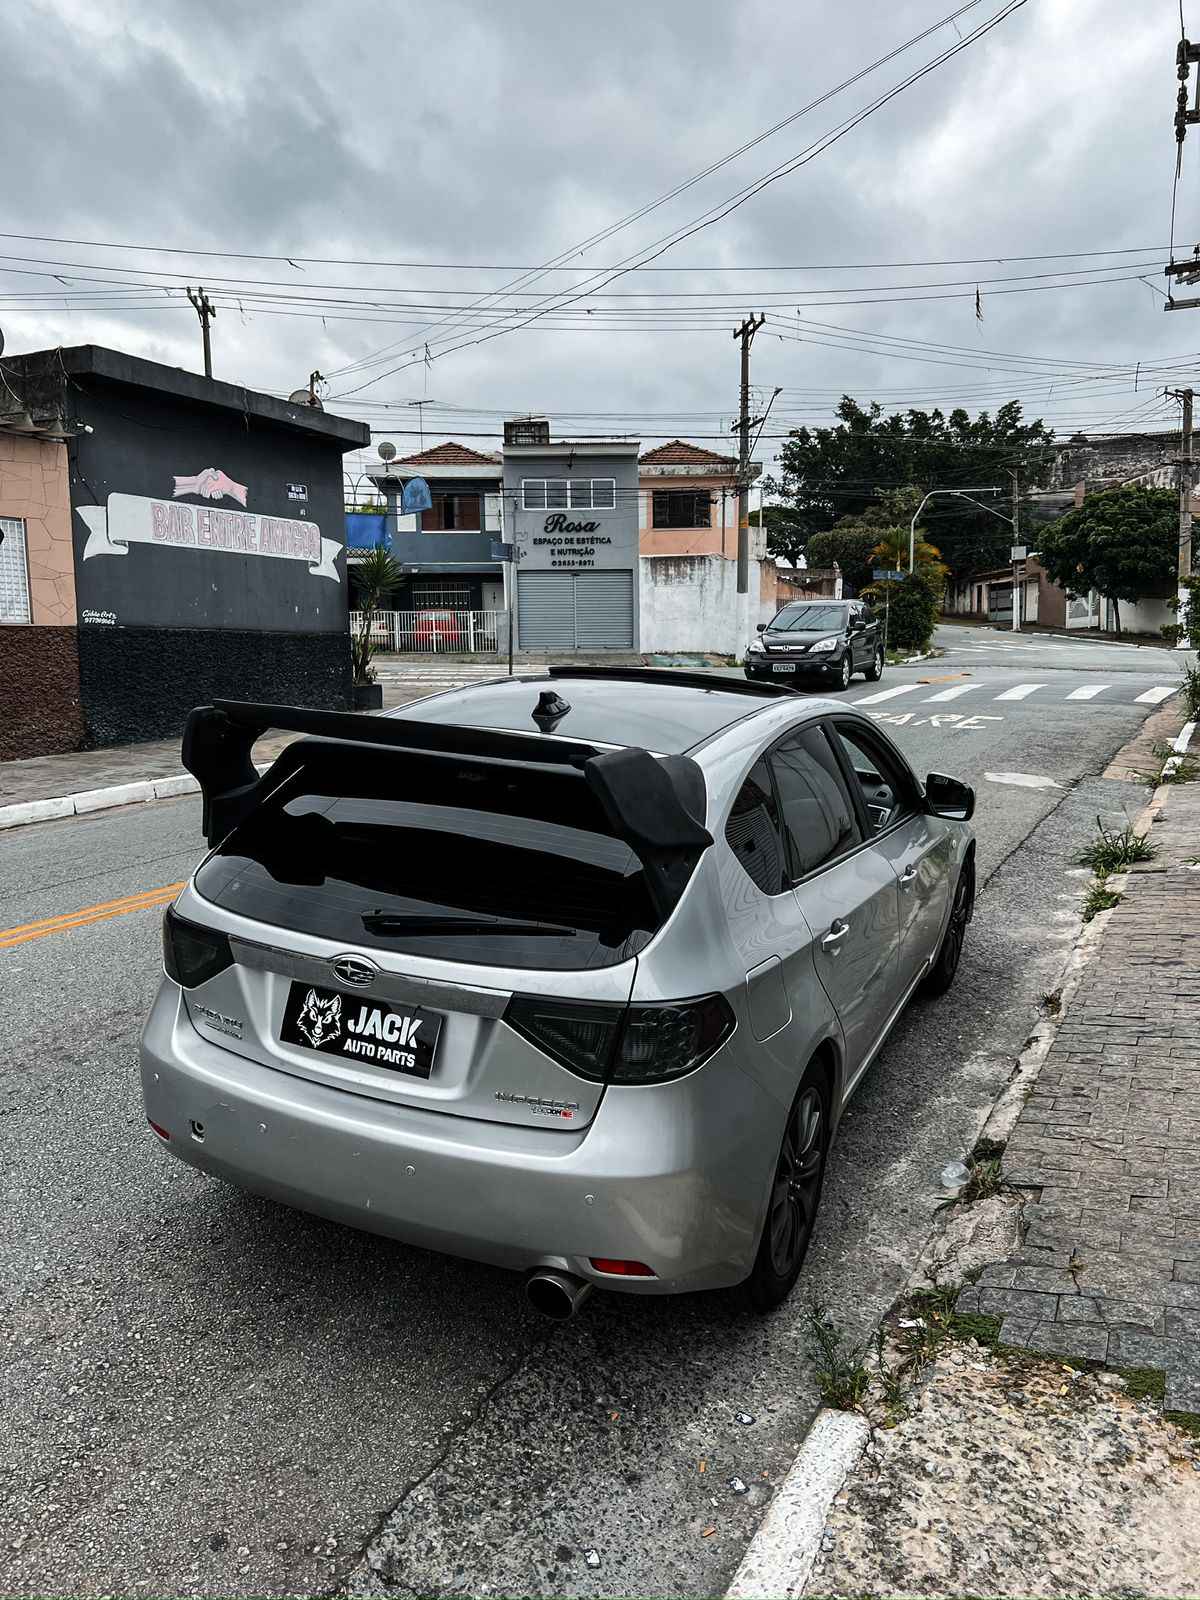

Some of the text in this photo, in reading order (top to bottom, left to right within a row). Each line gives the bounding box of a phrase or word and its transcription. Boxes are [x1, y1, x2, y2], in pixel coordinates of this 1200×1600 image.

[151, 501, 321, 559] BAR ENTRE AMIGOS
[544, 513, 601, 534] Rosa
[533, 535, 612, 546] ESPAÇO DE ESTÉTICA
[550, 546, 596, 557] E NUTRIÇÃO
[347, 1006, 424, 1049] JACK
[343, 1038, 416, 1068] AUTO PARTS
